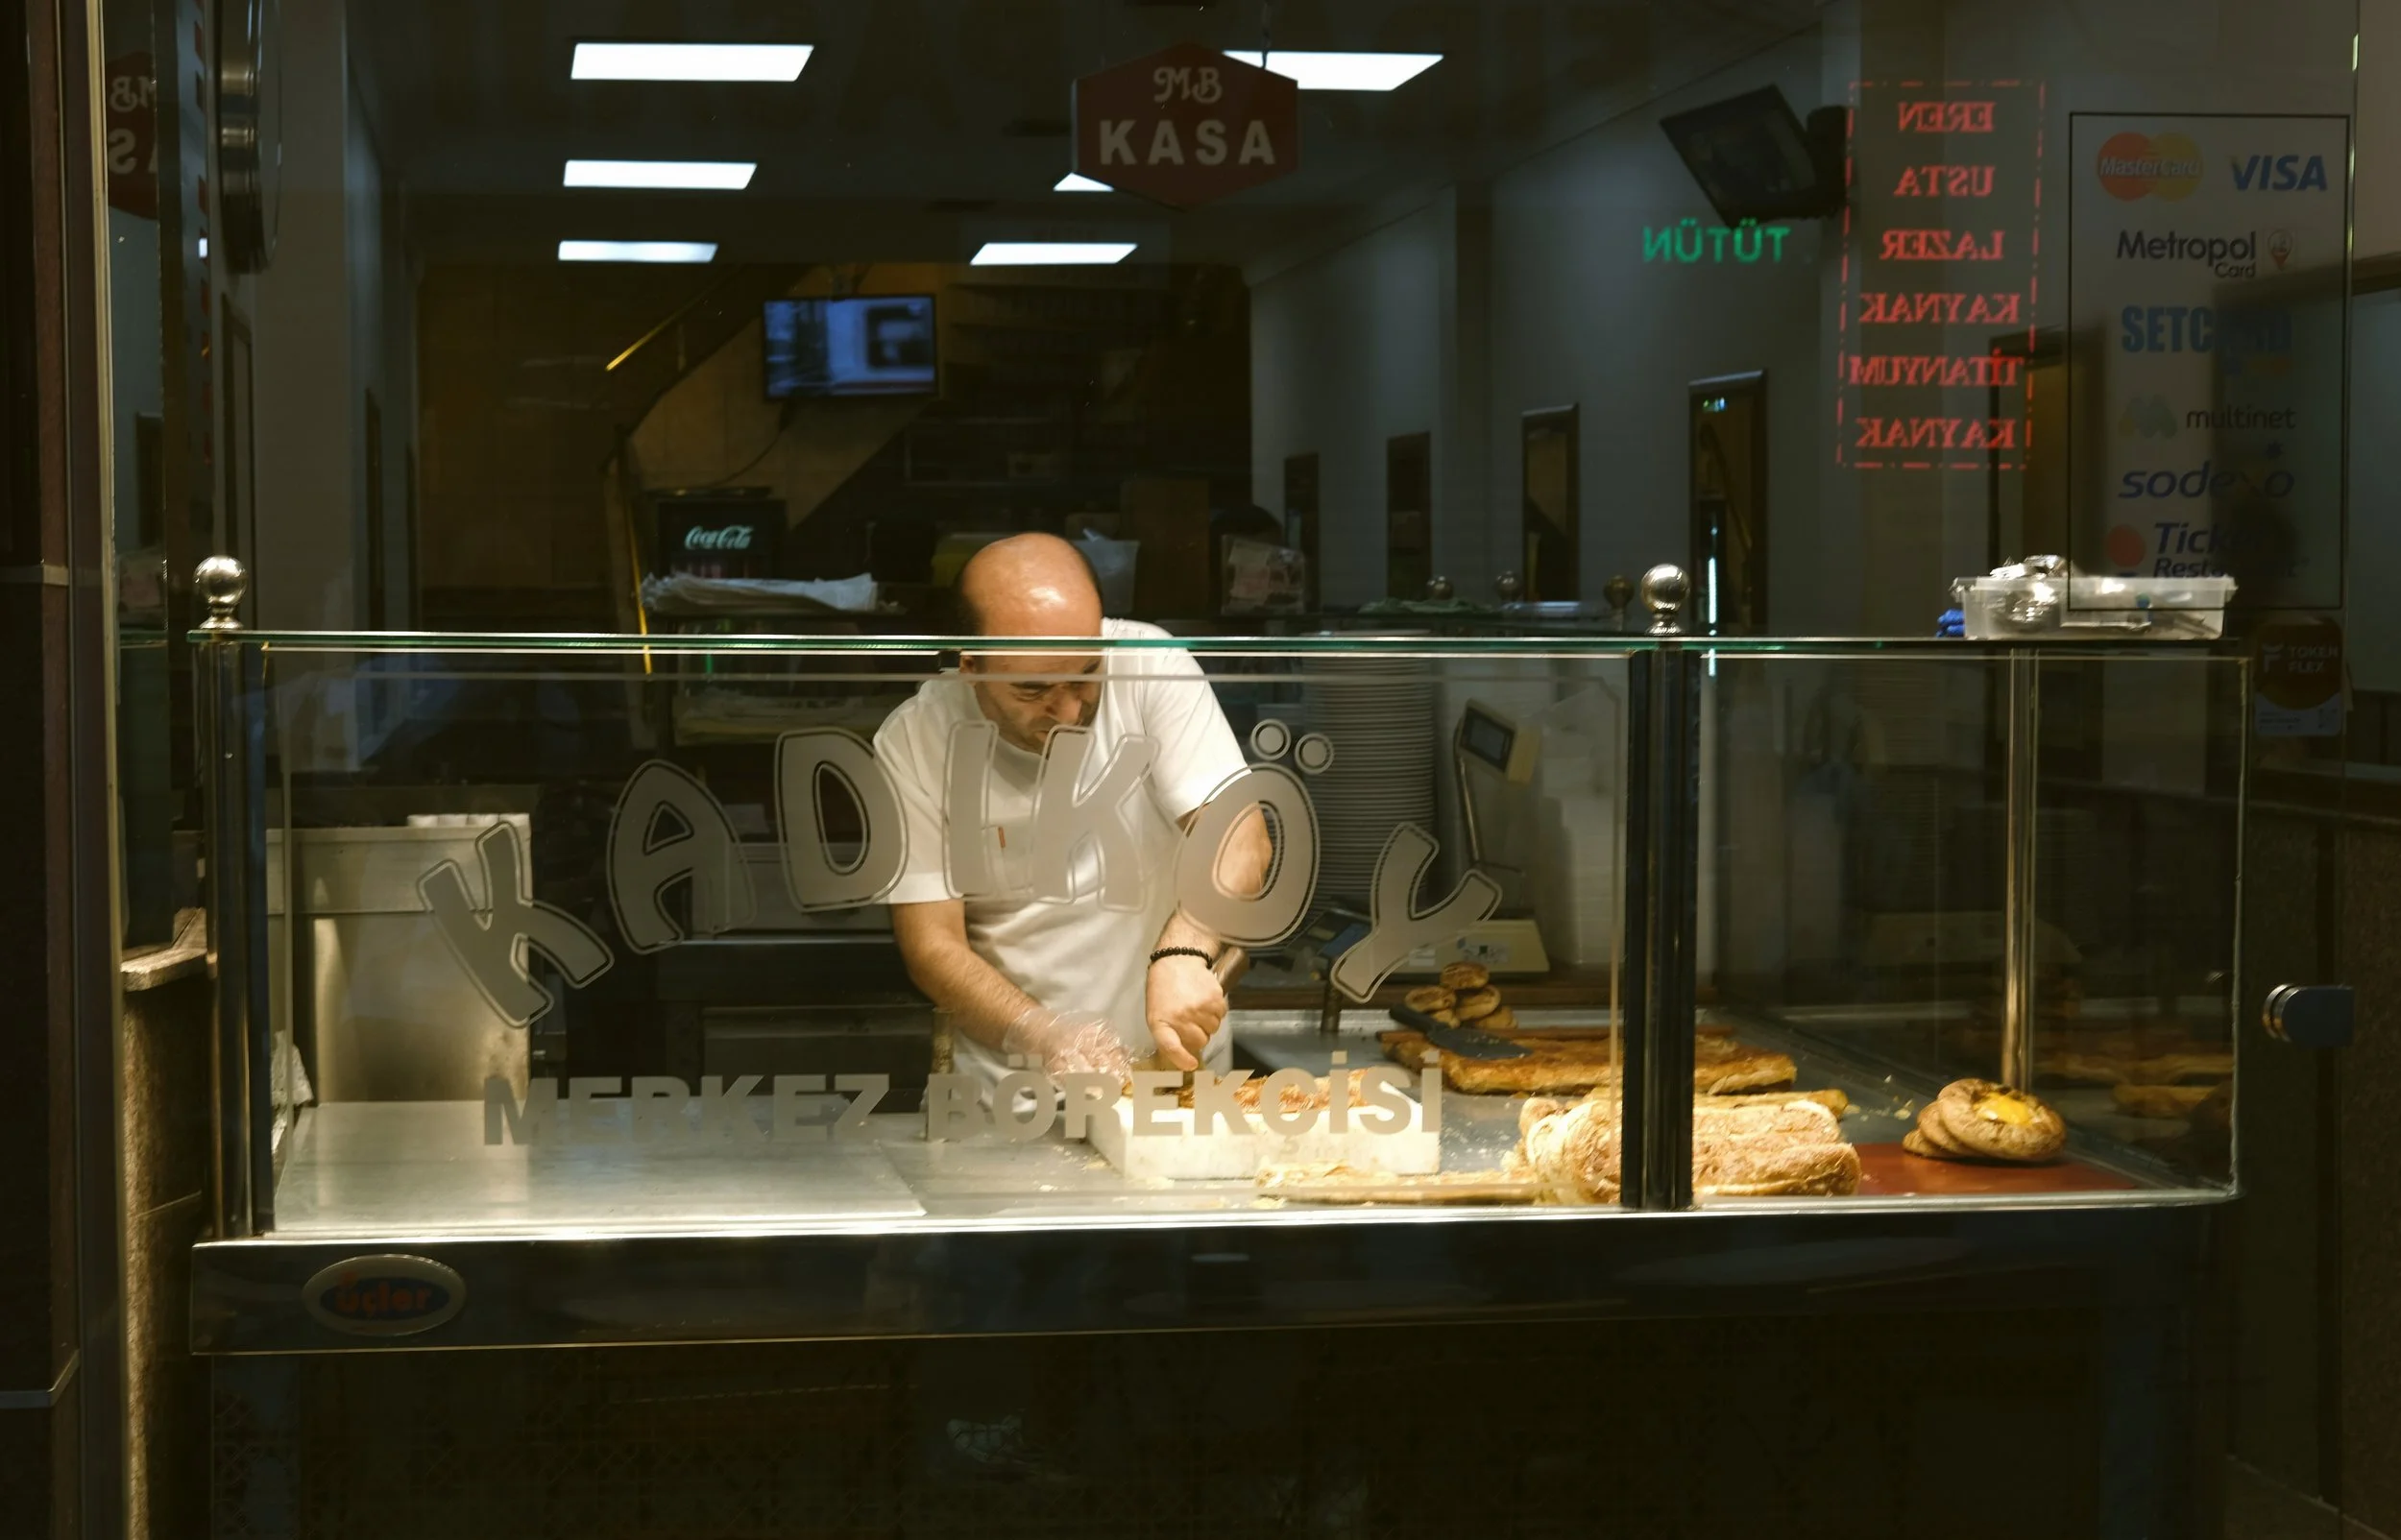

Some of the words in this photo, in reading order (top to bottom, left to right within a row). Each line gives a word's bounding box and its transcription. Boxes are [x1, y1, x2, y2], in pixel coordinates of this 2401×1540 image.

[1153, 66, 1223, 104] MB
[1100, 119, 1275, 165] KASA
[2099, 155, 2201, 178] MasterCard
[2230, 154, 2328, 191] VISA
[2116, 229, 2257, 267] Metropol
[2214, 262, 2256, 278] Card
[2186, 403, 2296, 429] multinet
[2288, 645, 2340, 658] TOKEN
[417, 718, 1502, 1027] KADIKÖY
[483, 1073, 890, 1145] MERKEZ
